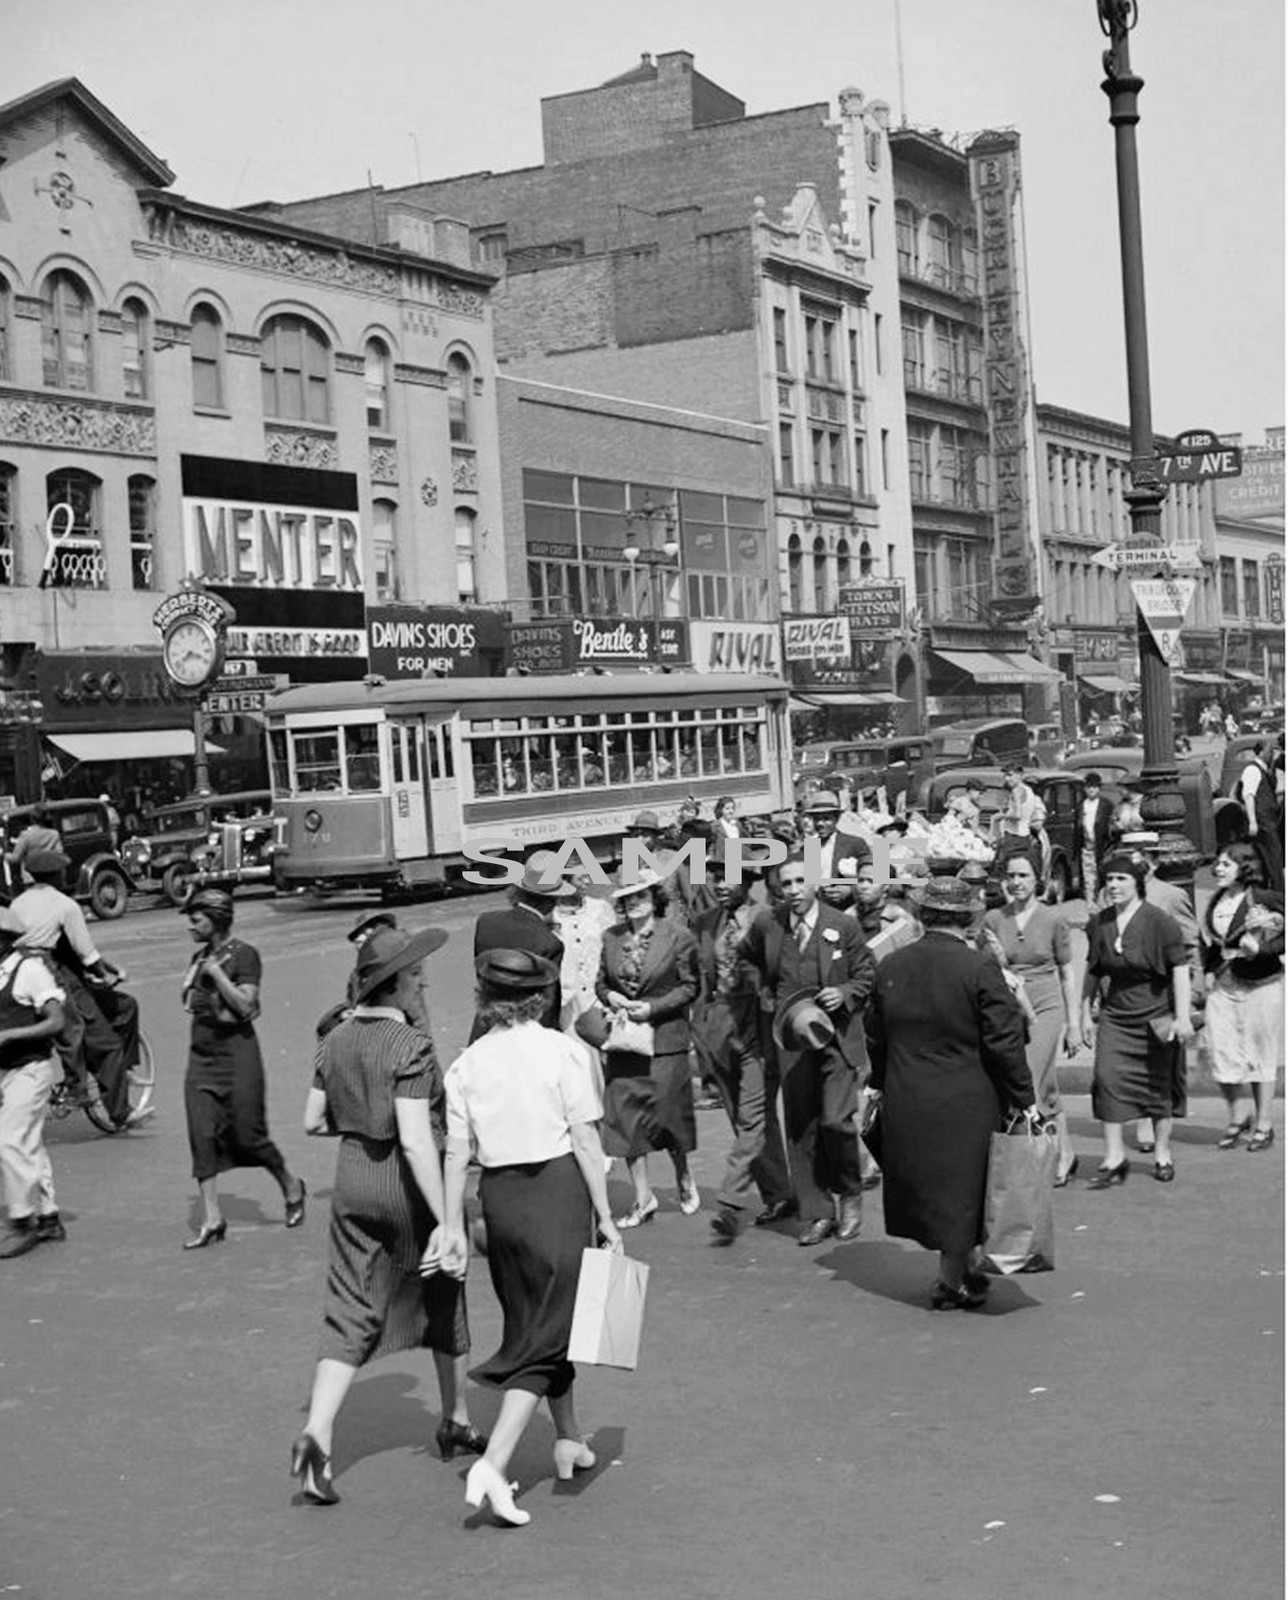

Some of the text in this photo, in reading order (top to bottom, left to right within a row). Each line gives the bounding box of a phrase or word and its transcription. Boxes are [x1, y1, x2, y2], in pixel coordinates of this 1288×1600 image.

[1199, 452, 1239, 474] AVE
[195, 505, 362, 588] VENTER
[1108, 550, 1177, 563] TERMINAL
[371, 622, 476, 648] DAVINS SHOES
[788, 622, 844, 643] RIVAL
[708, 632, 775, 671] RIVAL
[398, 657, 453, 672] FOR MEN
[512, 824, 557, 837] THIRD
